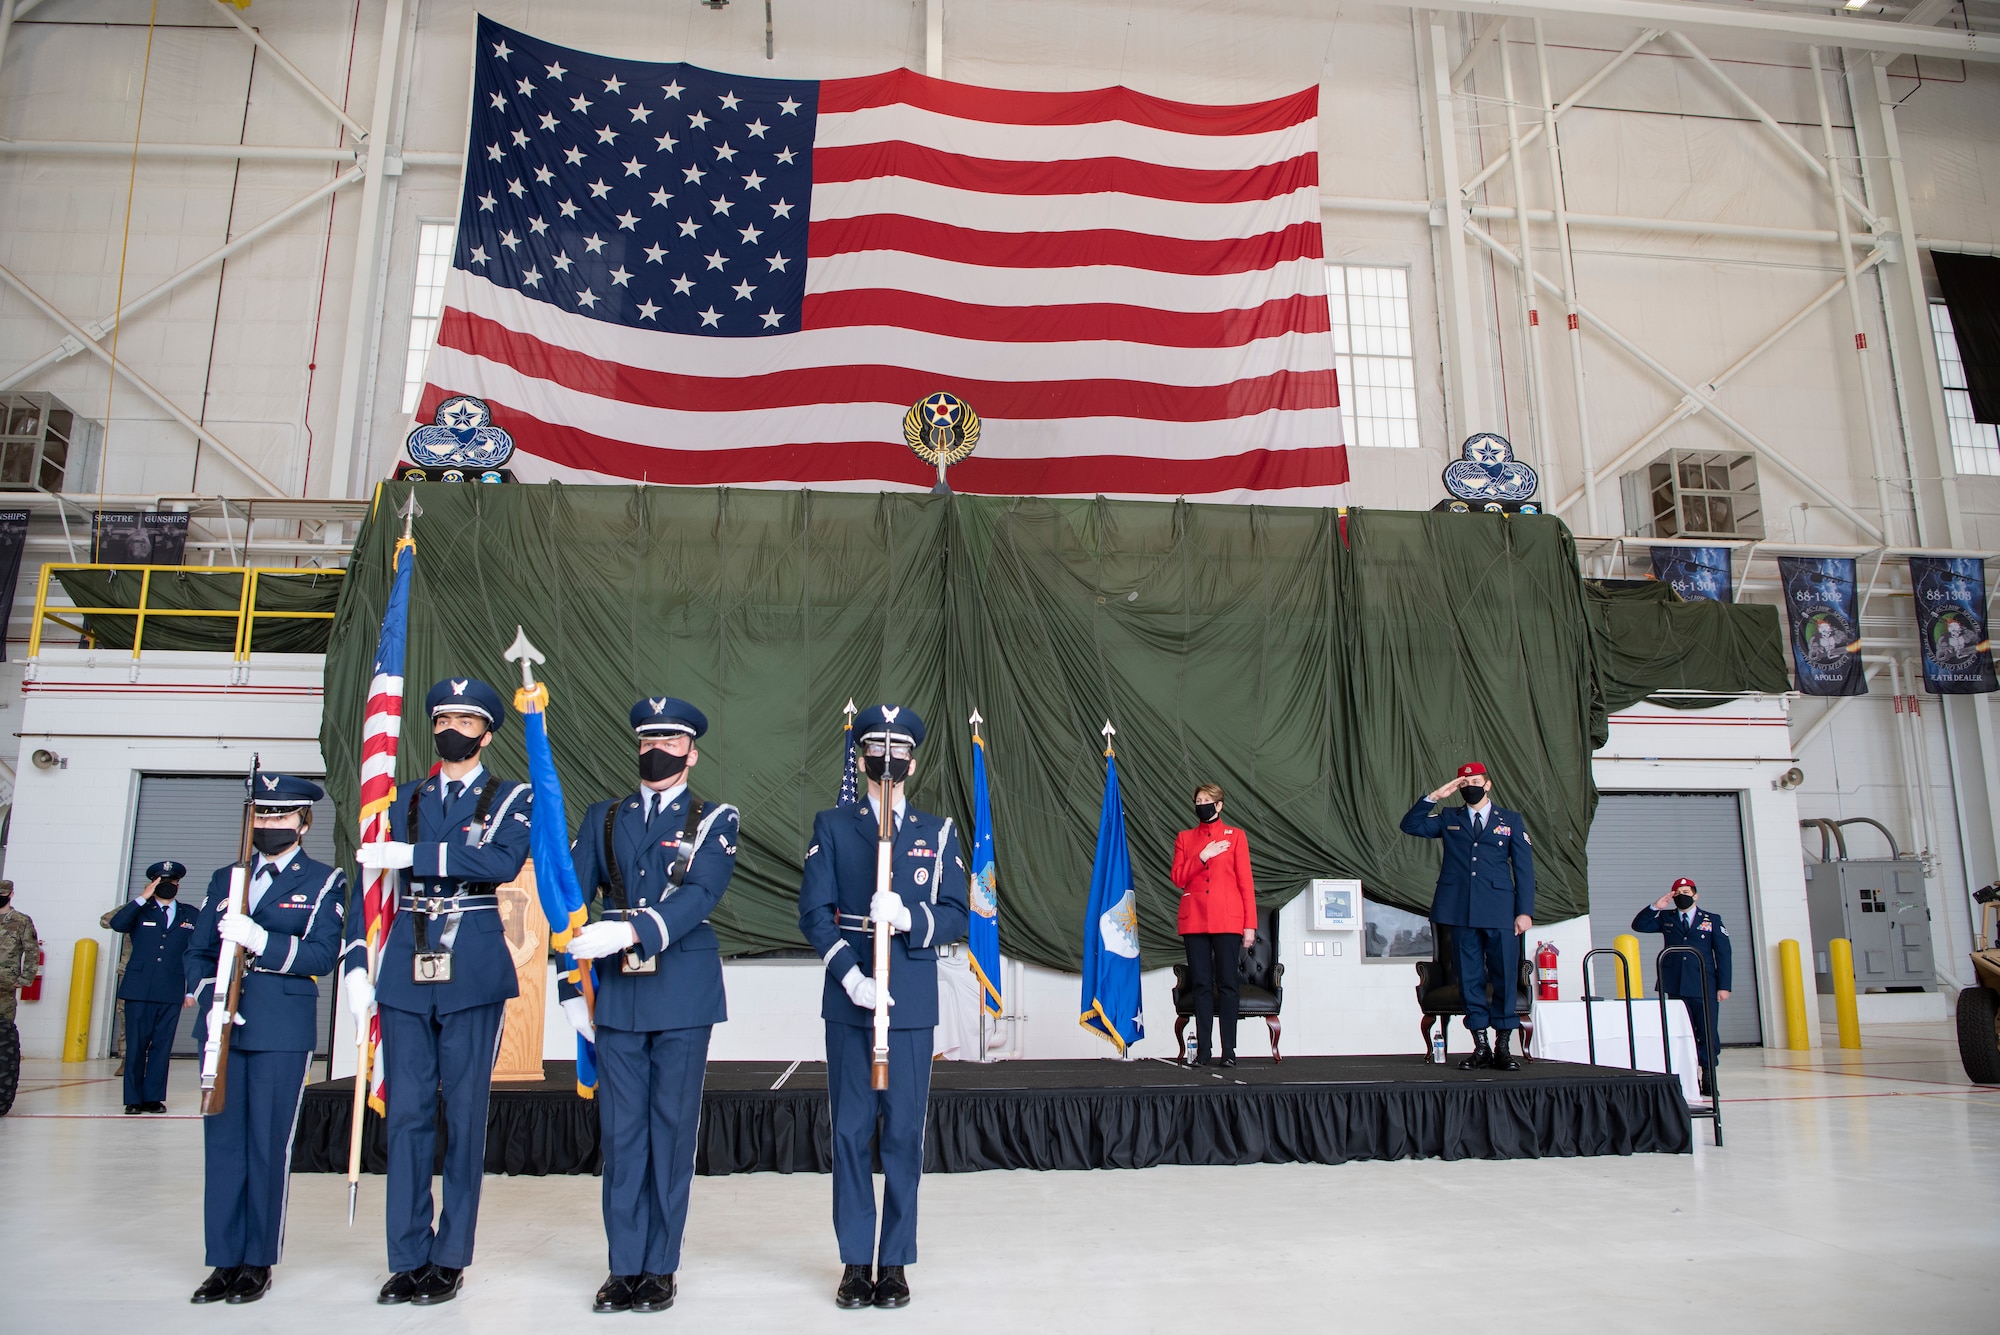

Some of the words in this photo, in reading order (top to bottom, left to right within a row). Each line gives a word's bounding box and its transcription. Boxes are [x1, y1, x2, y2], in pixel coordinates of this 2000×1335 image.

[94, 514, 134, 523] SPECTRE
[144, 515, 188, 523] GUNSHIPS
[1671, 581, 1716, 592] 88-1301
[1796, 591, 1843, 602] 88-1302
[1814, 674, 1843, 682] APOLLO
[1953, 674, 1983, 682] DEALER
